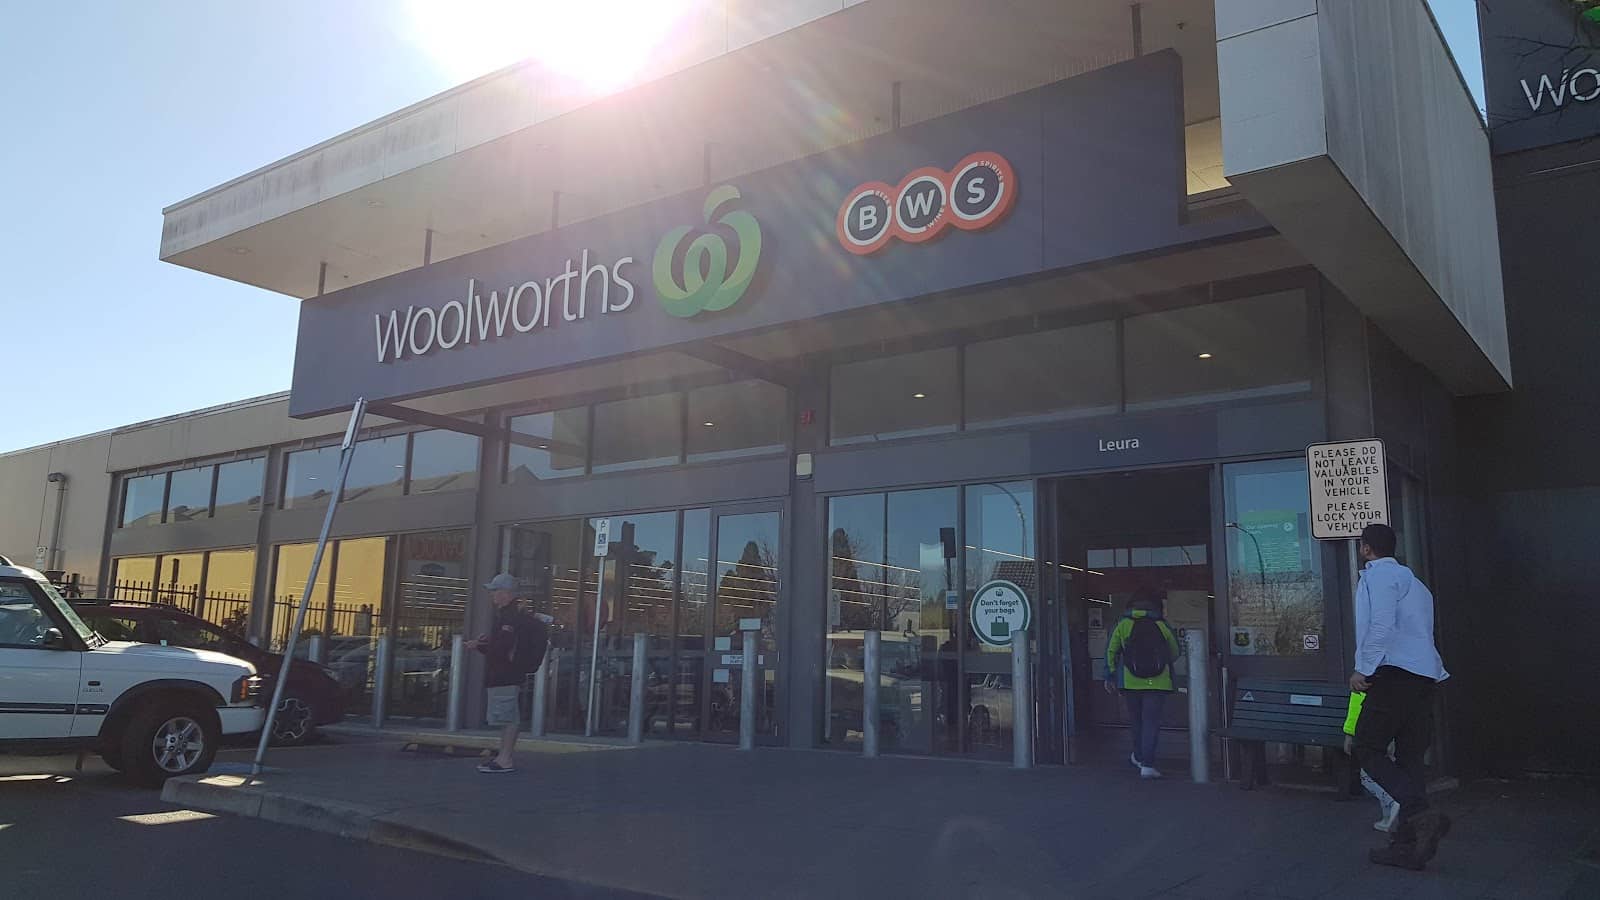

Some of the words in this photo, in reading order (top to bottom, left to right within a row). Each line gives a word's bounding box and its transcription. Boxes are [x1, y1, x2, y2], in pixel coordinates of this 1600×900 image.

[375, 248, 634, 363] Woolworths
[1099, 438, 1139, 452] Leura
[1314, 448, 1356, 458] PLEASE
[1362, 446, 1376, 455] DO
[1315, 459, 1335, 468] NOT
[1341, 456, 1377, 467] LEAVE
[1315, 466, 1379, 477] VALUABLES
[1324, 479, 1334, 488] IN
[1341, 476, 1370, 486] YOUR
[1325, 486, 1371, 497] VEHICLE
[1327, 501, 1371, 512] PLEASE
[1317, 512, 1345, 522] LOCK
[1352, 510, 1381, 520] YOUR
[1000, 599, 1019, 607] forget
